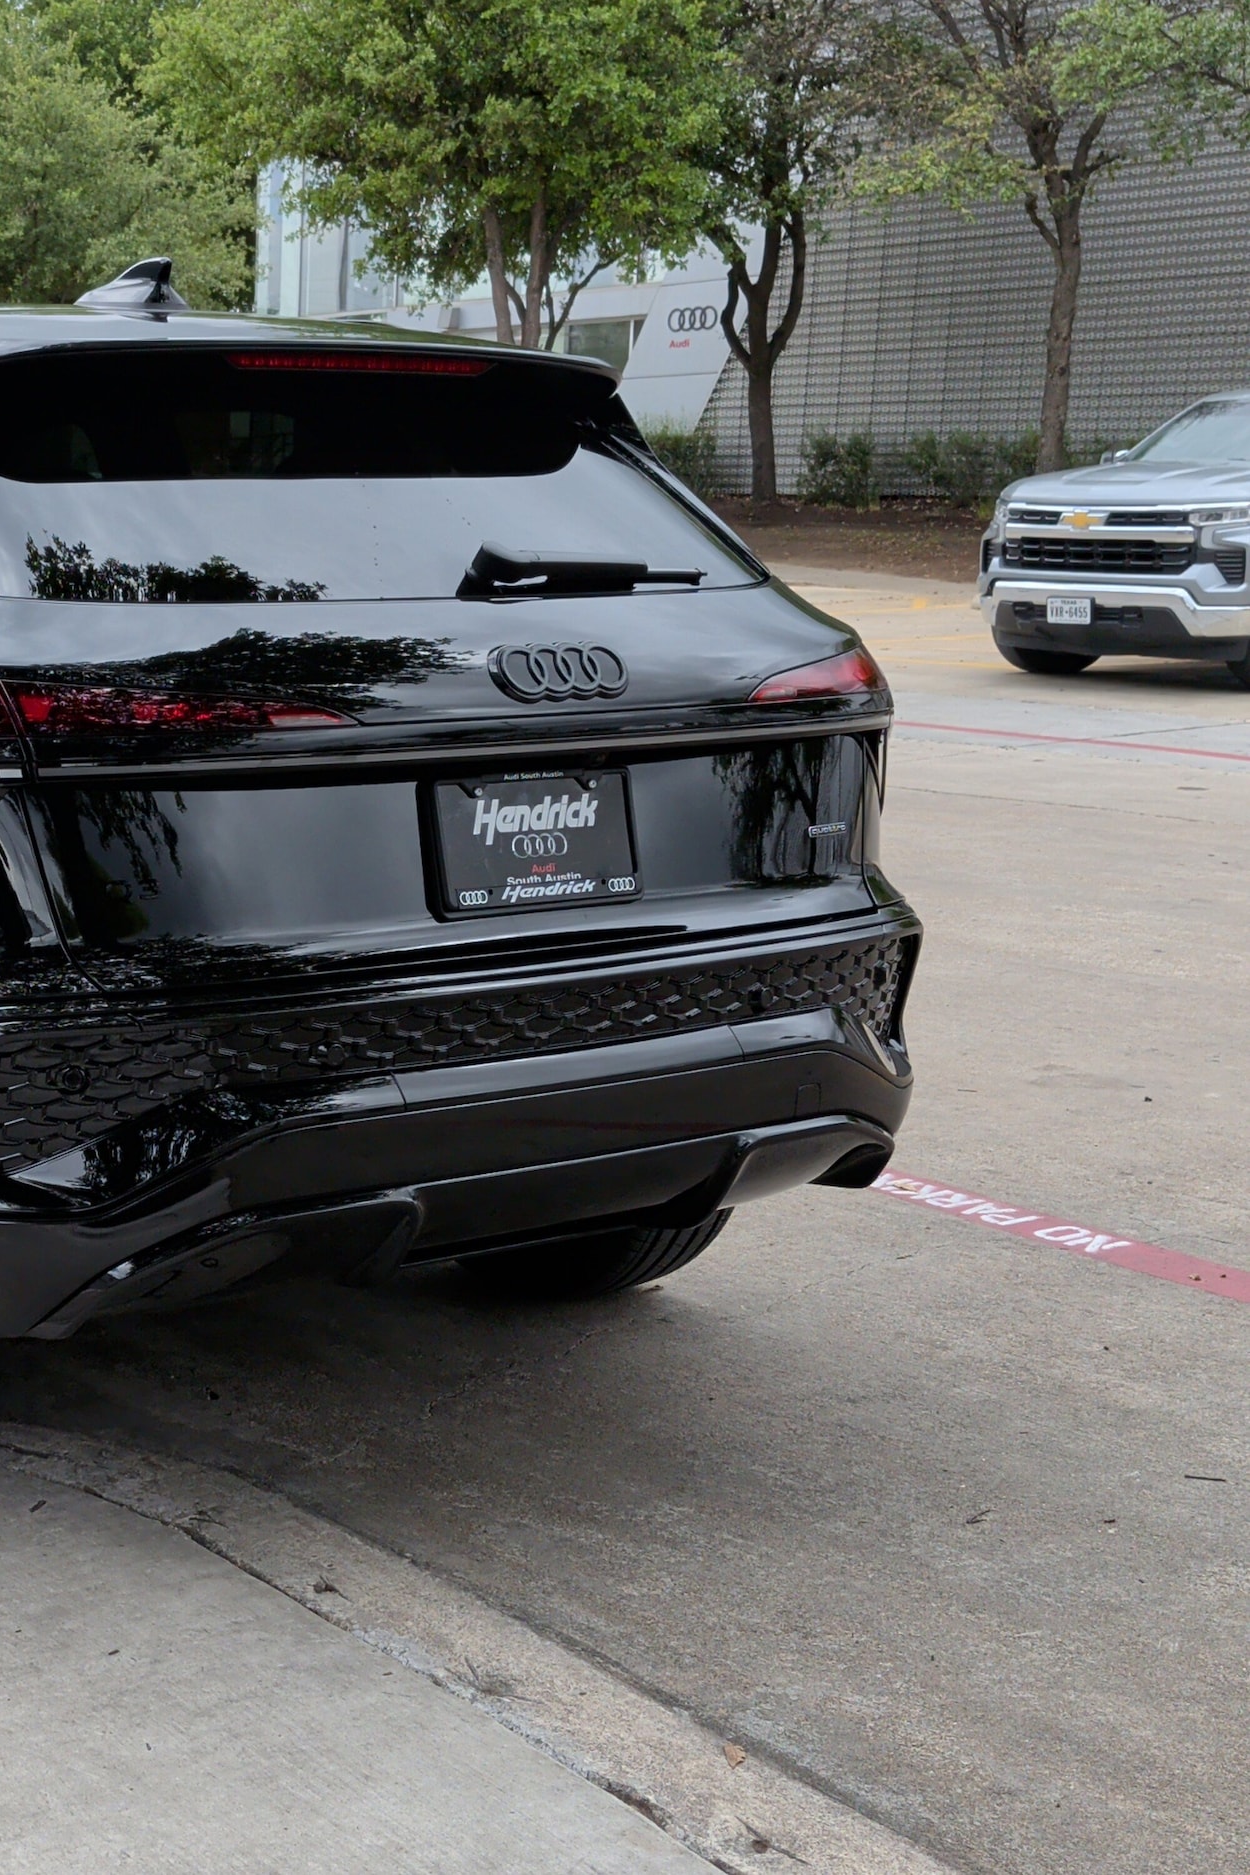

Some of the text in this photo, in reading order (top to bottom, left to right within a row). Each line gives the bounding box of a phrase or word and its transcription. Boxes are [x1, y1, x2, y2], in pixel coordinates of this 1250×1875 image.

[669, 338, 690, 349] Audi
[504, 770, 565, 781] Audi South Austin
[472, 792, 599, 846] Hendrick
[531, 862, 556, 874] Audi
[545, 871, 582, 883] Austin
[501, 879, 597, 904] Hendrick
[1033, 1225, 1133, 1253] NO
